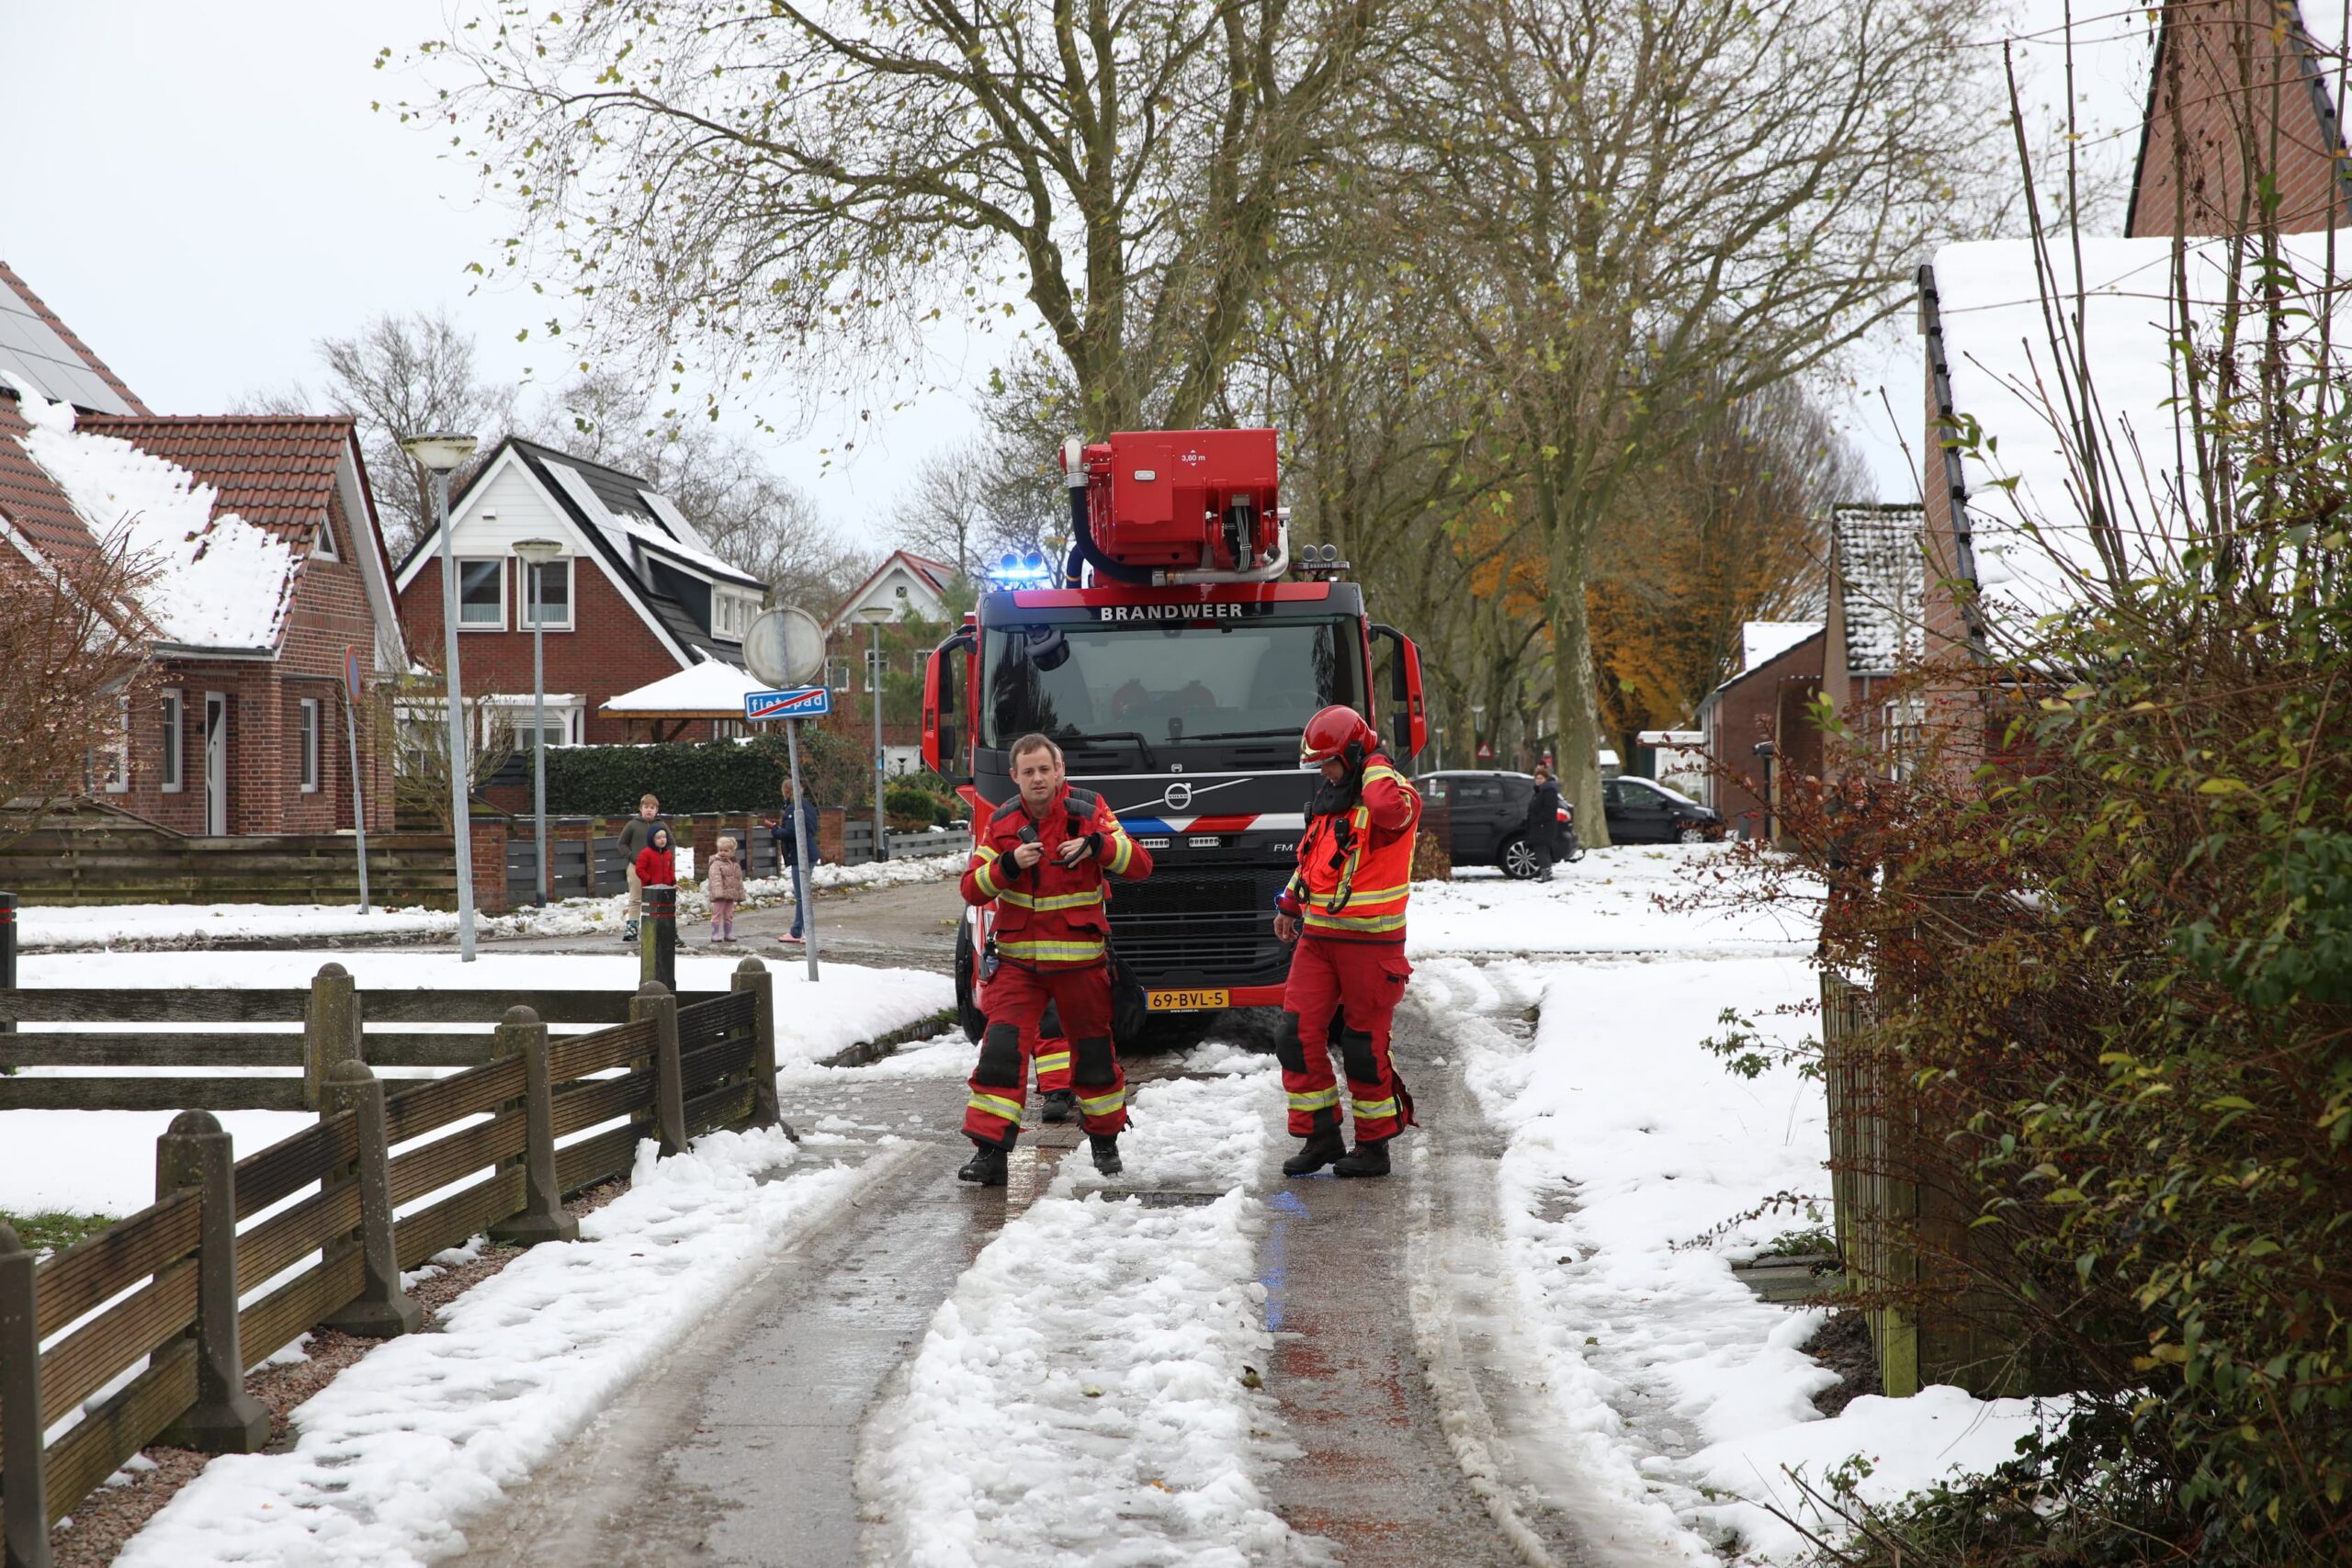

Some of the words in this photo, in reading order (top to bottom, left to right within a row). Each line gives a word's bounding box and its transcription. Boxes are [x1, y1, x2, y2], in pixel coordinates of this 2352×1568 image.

[1101, 604, 1243, 621] BRANDWEER
[1273, 843, 1294, 852] FM
[1153, 992, 1224, 1008] 69-BVL-5
